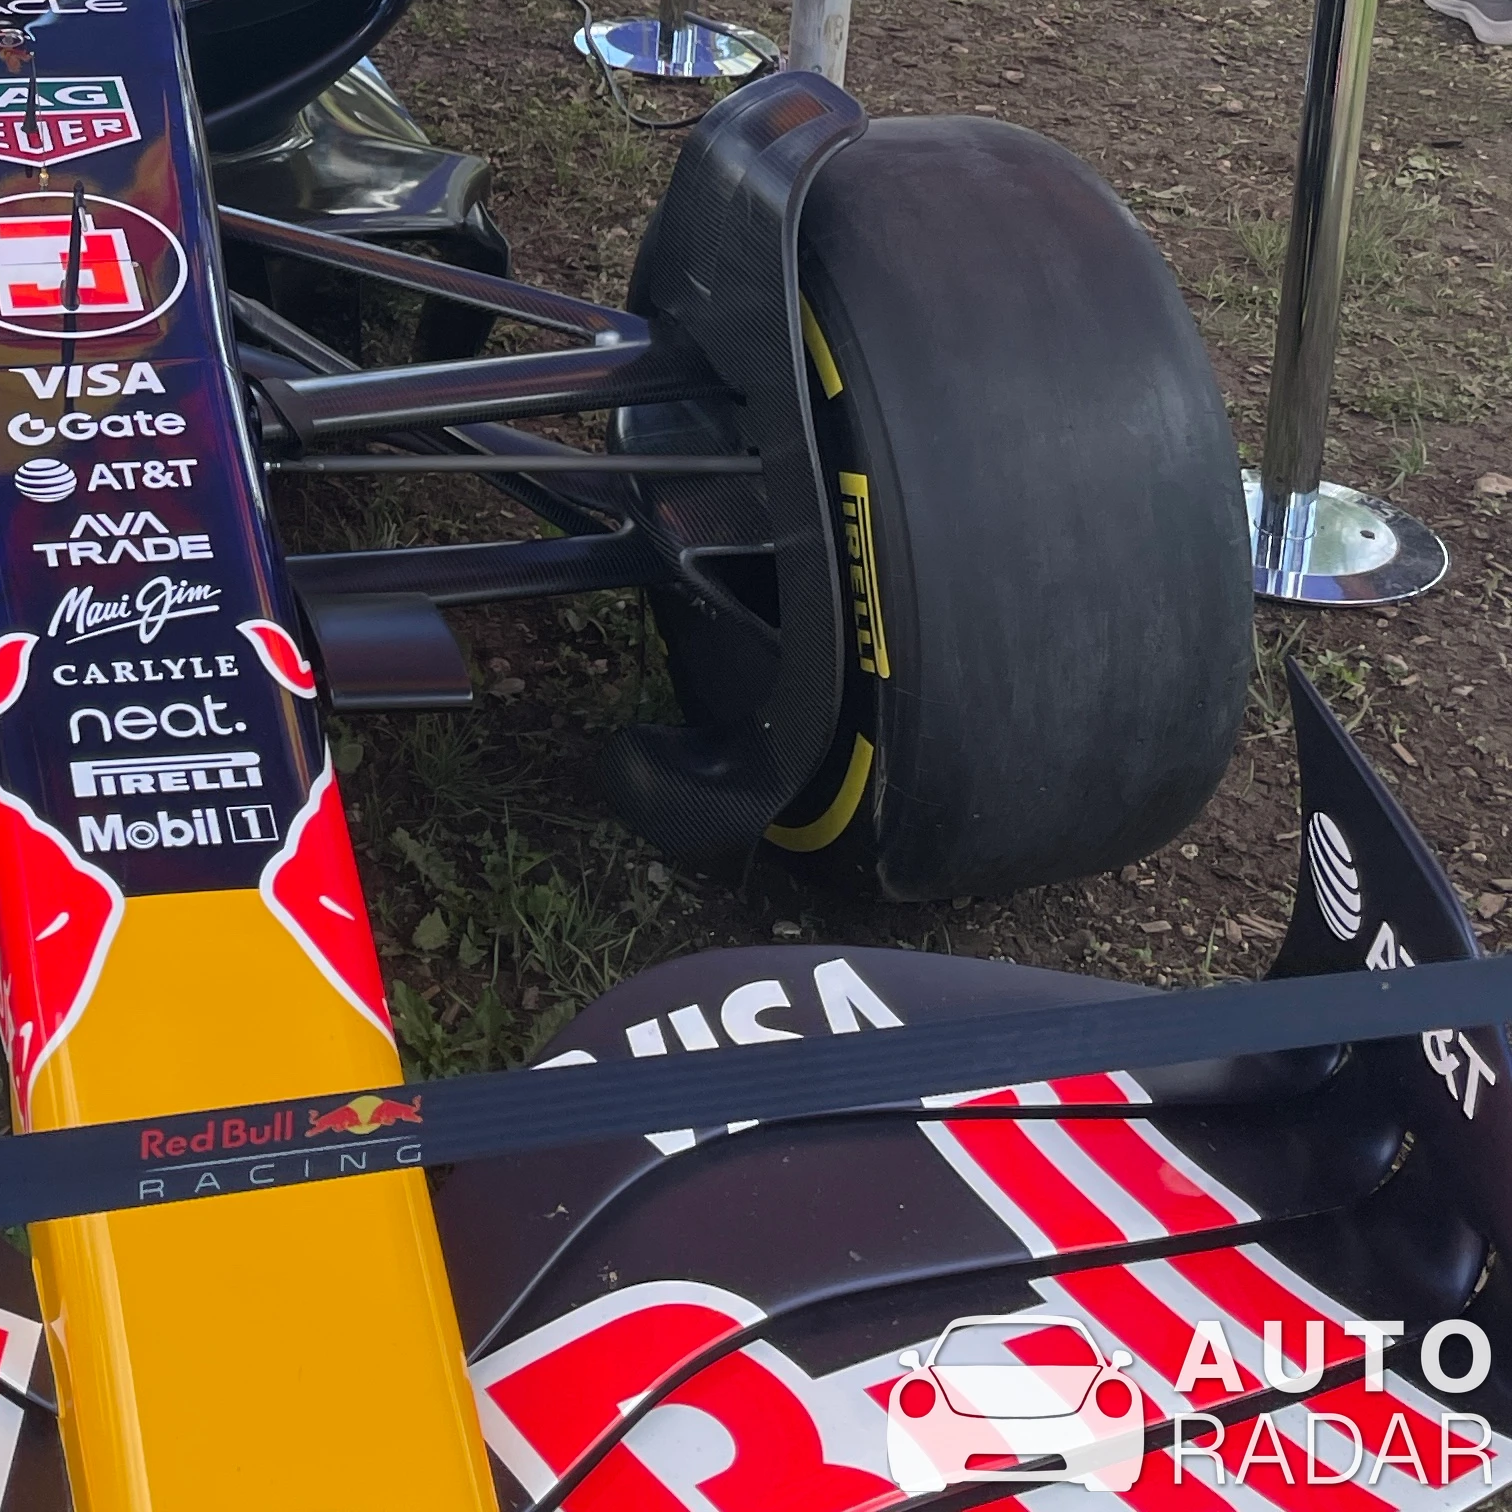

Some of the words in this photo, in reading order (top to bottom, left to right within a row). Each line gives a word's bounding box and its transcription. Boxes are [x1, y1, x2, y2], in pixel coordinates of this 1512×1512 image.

[9, 361, 167, 400] VISA
[58, 410, 187, 441] Gate
[87, 458, 198, 492] AT&T
[69, 511, 170, 539] AVA
[32, 534, 215, 568] TRADE
[839, 471, 891, 680] PIRELLI
[47, 585, 133, 638] Maui
[135, 575, 222, 644] Jim
[52, 654, 239, 686] CARLYLE
[69, 694, 247, 744] neat.
[69, 751, 263, 798] PIRELLI
[78, 807, 223, 853] Mobil
[140, 1119, 215, 1161] Red
[222, 1110, 293, 1149] Bull
[140, 1143, 422, 1200] RACING
